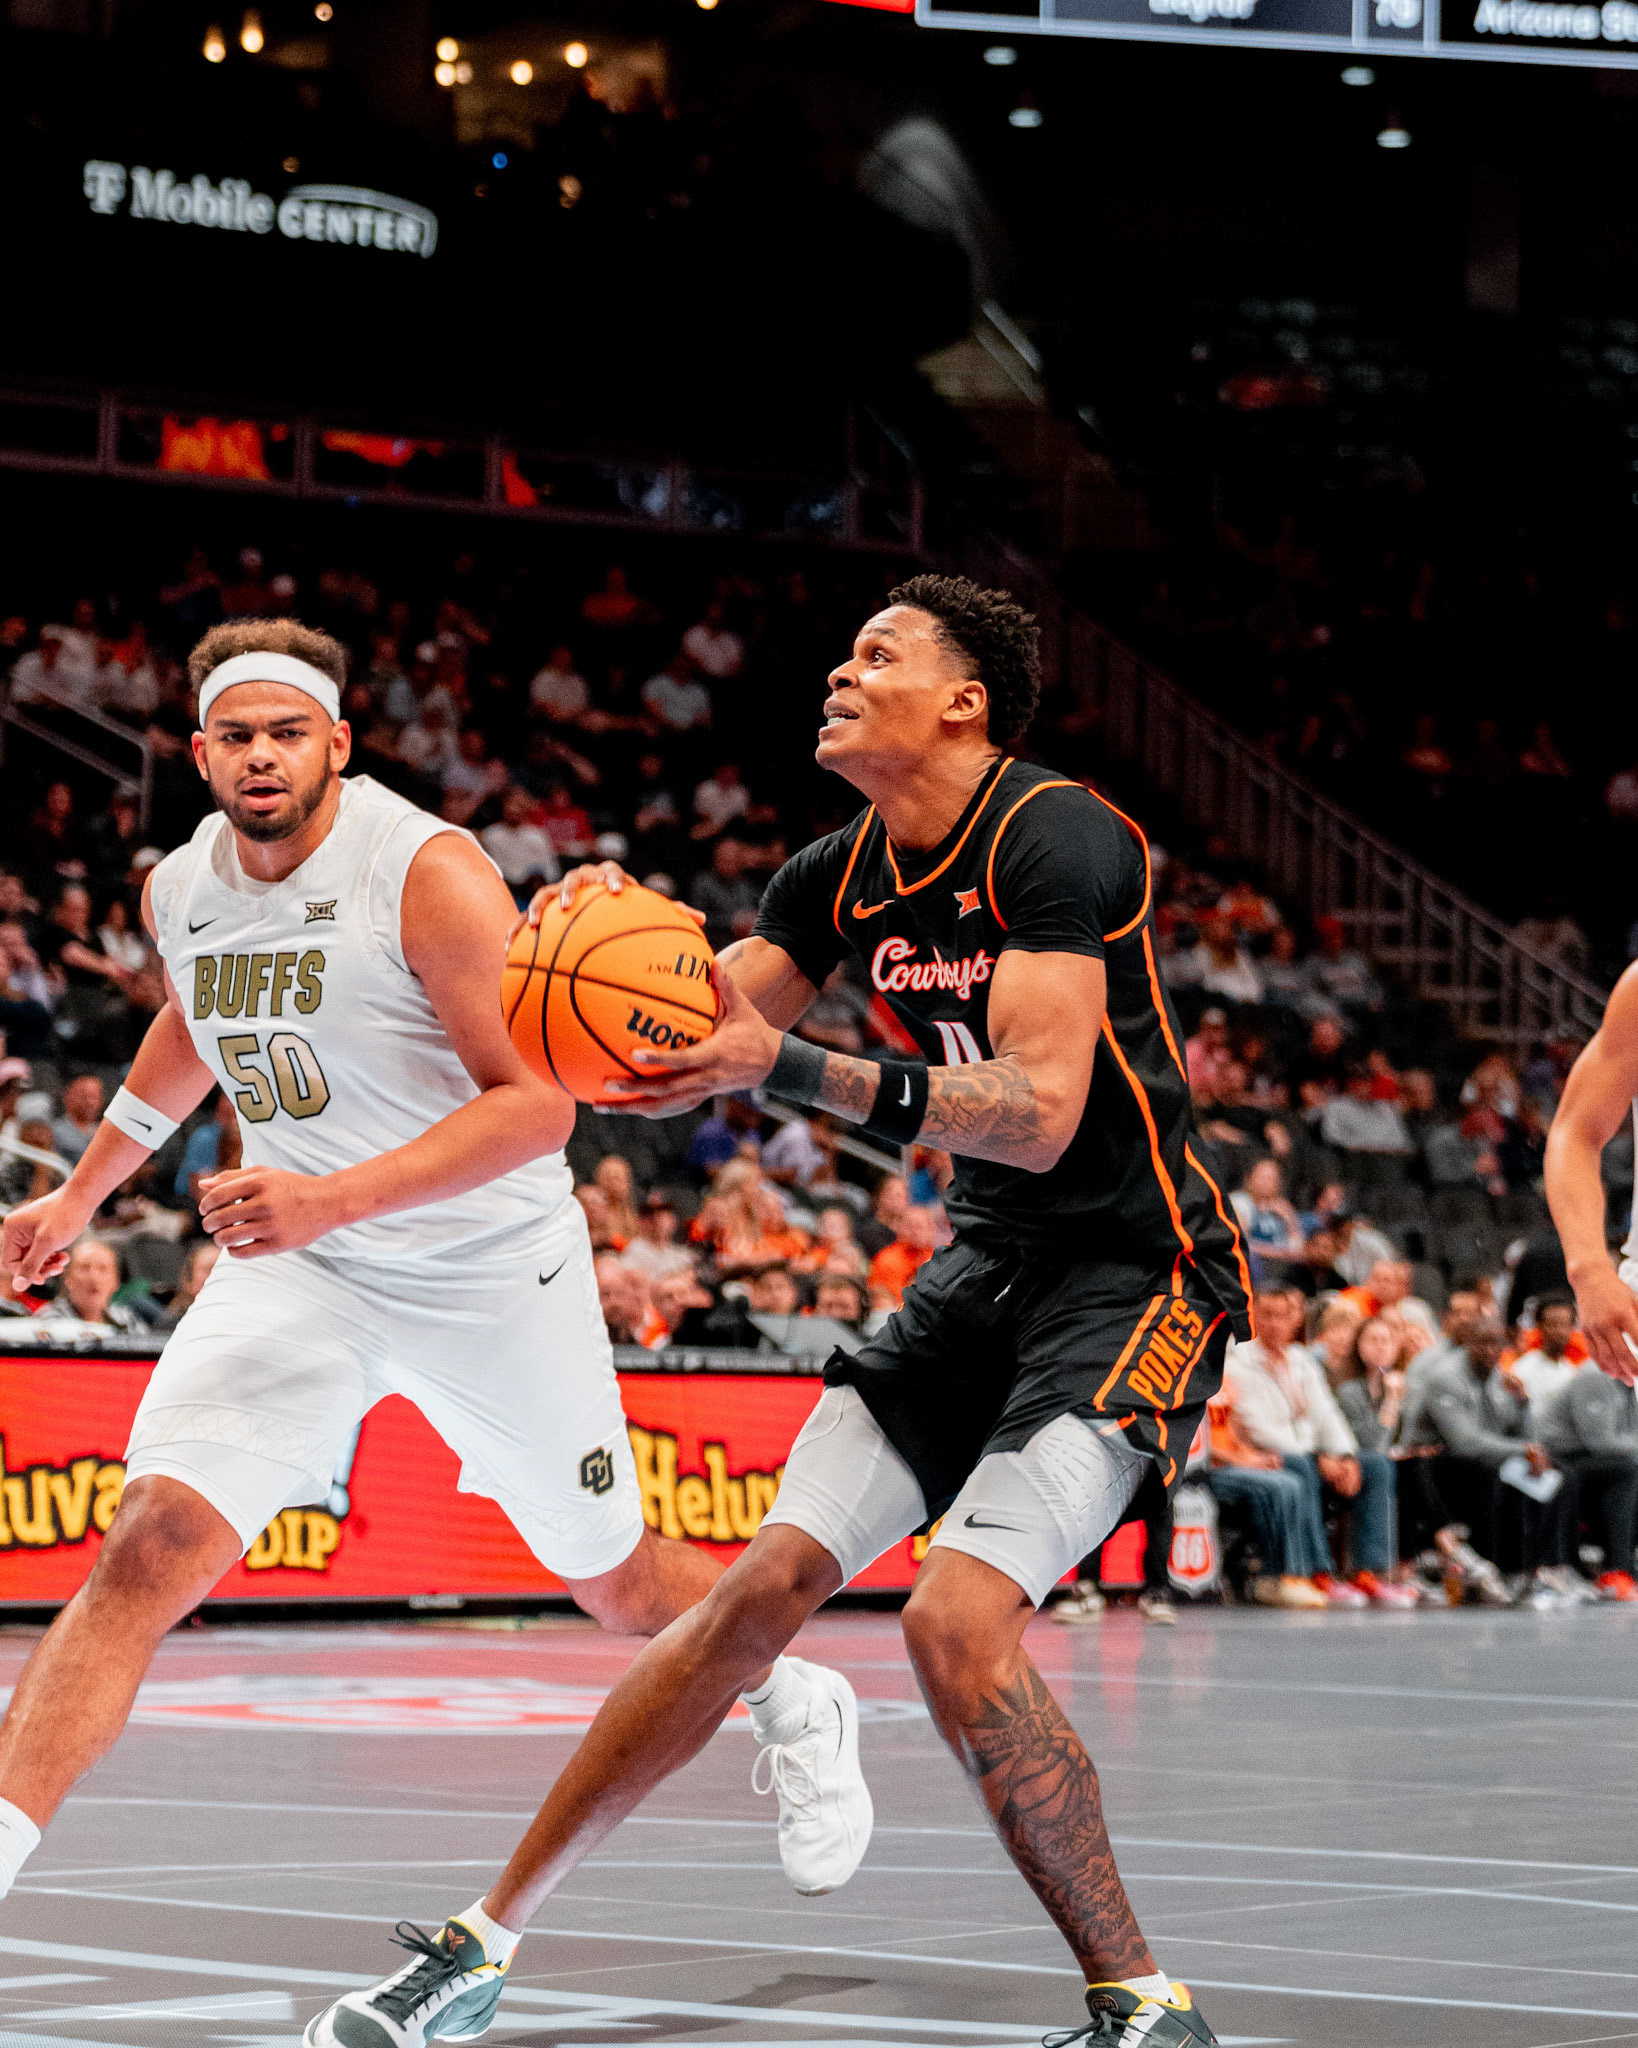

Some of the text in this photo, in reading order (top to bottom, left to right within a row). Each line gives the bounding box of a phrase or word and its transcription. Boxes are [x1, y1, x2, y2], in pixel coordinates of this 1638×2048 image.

[1473, 0, 1599, 40] Arizona
[130, 165, 275, 234] Mobile
[277, 197, 425, 254] CENTER
[193, 950, 326, 1020] BUFFS
[626, 1007, 702, 1050] son
[217, 1032, 331, 1123] 50
[1127, 1298, 1203, 1411] POKES
[245, 1508, 340, 1571] DIP
